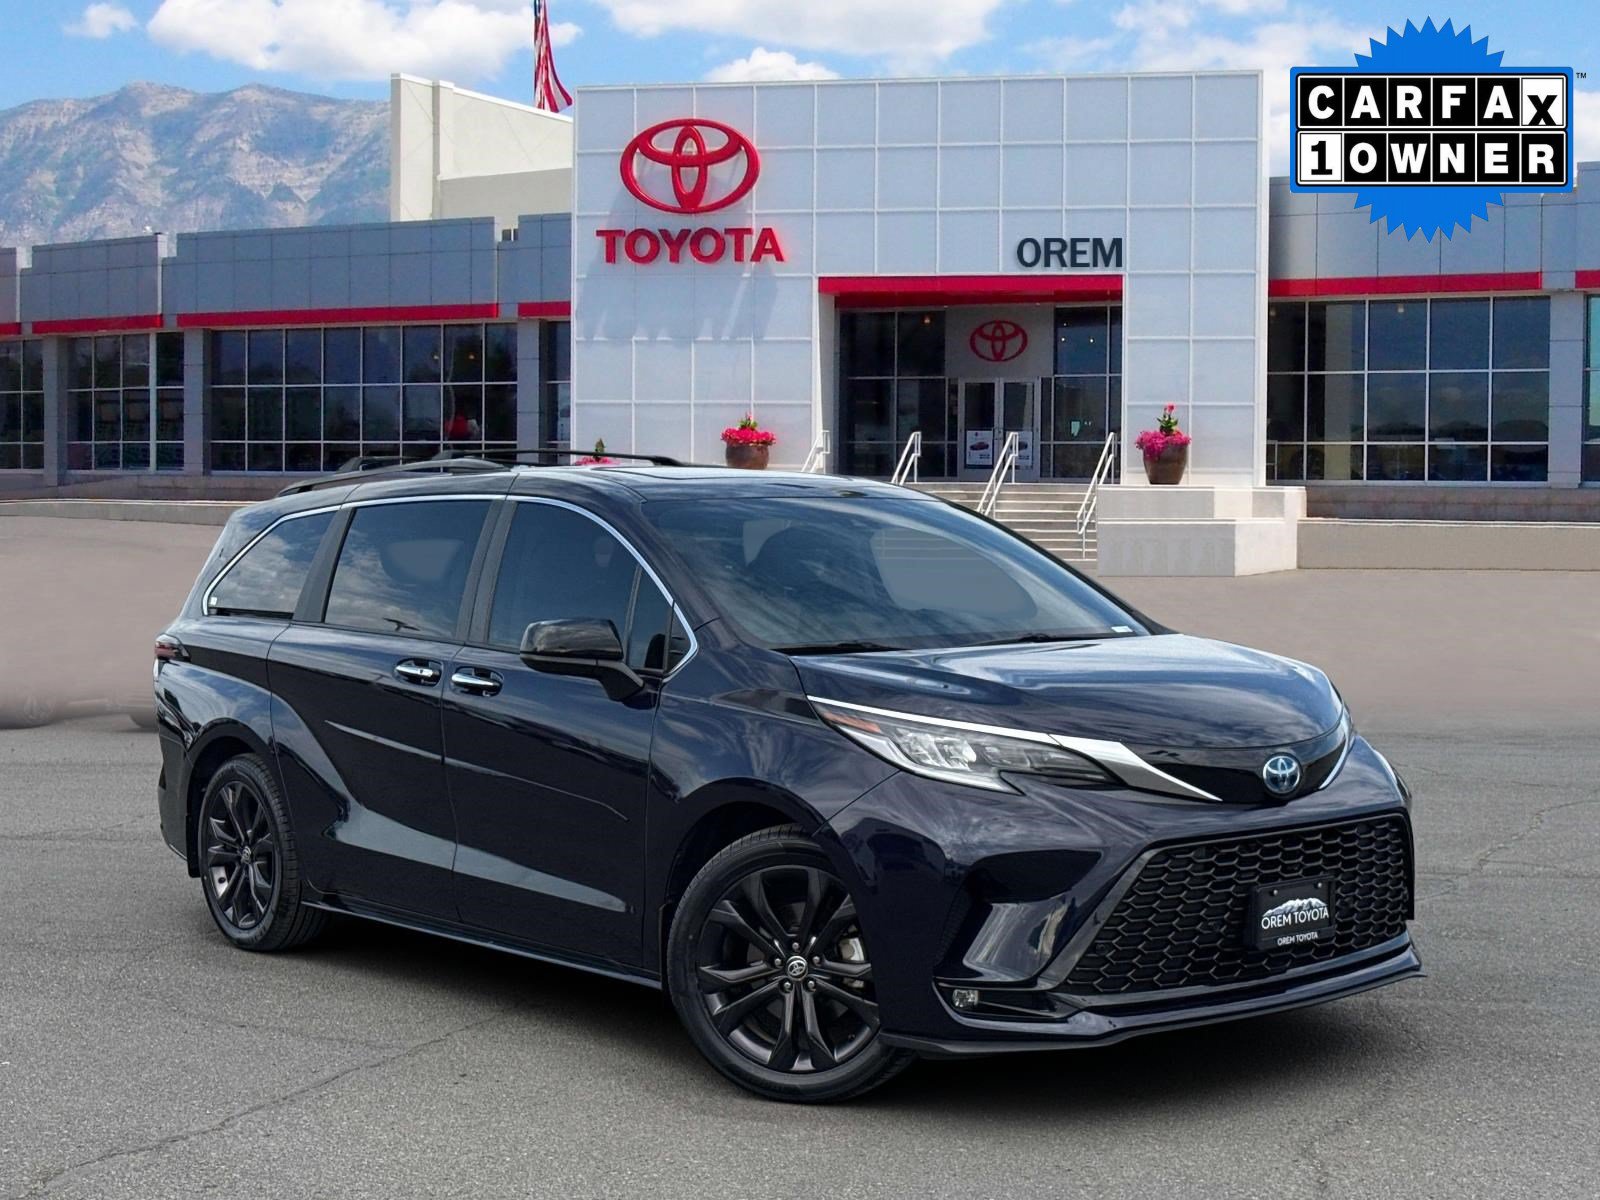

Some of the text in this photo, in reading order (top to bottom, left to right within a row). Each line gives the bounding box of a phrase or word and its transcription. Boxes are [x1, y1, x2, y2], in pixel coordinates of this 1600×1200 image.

[596, 227, 786, 265] TOYOTA
[1016, 237, 1123, 268] OREM
[1261, 907, 1329, 929] OREM TOYOTA
[1277, 932, 1318, 946] OREM TOYOTA
